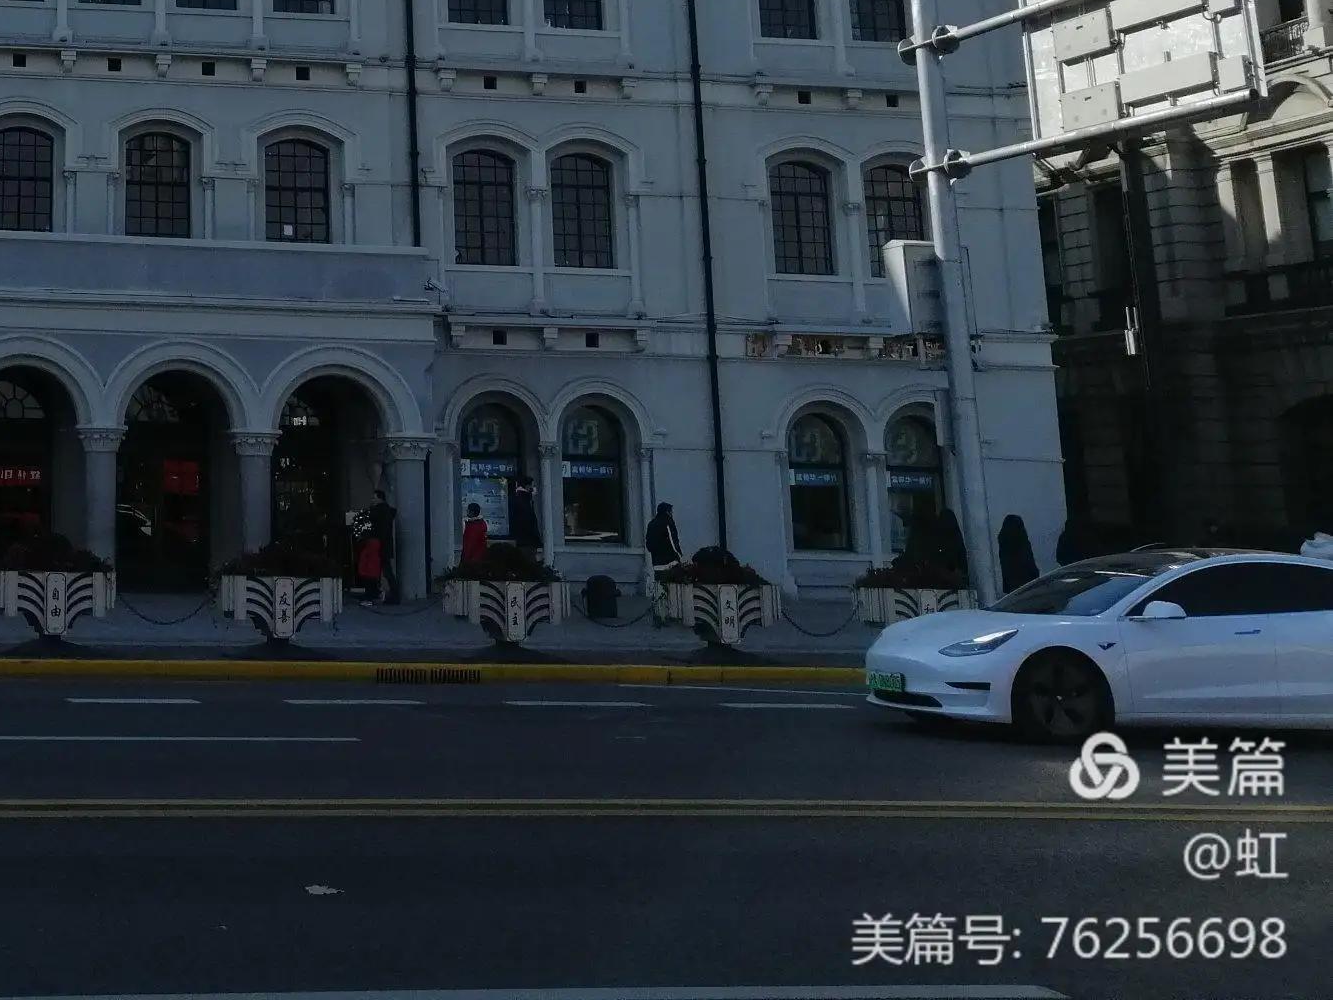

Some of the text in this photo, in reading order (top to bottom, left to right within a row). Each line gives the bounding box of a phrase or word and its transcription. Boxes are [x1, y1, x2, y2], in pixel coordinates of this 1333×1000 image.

[571, 465, 615, 475] 富邦华一银行
[51, 587, 62, 618] 自由
[277, 592, 291, 624] 友善
[510, 596, 522, 626] 民主
[724, 599, 735, 629] 文明
